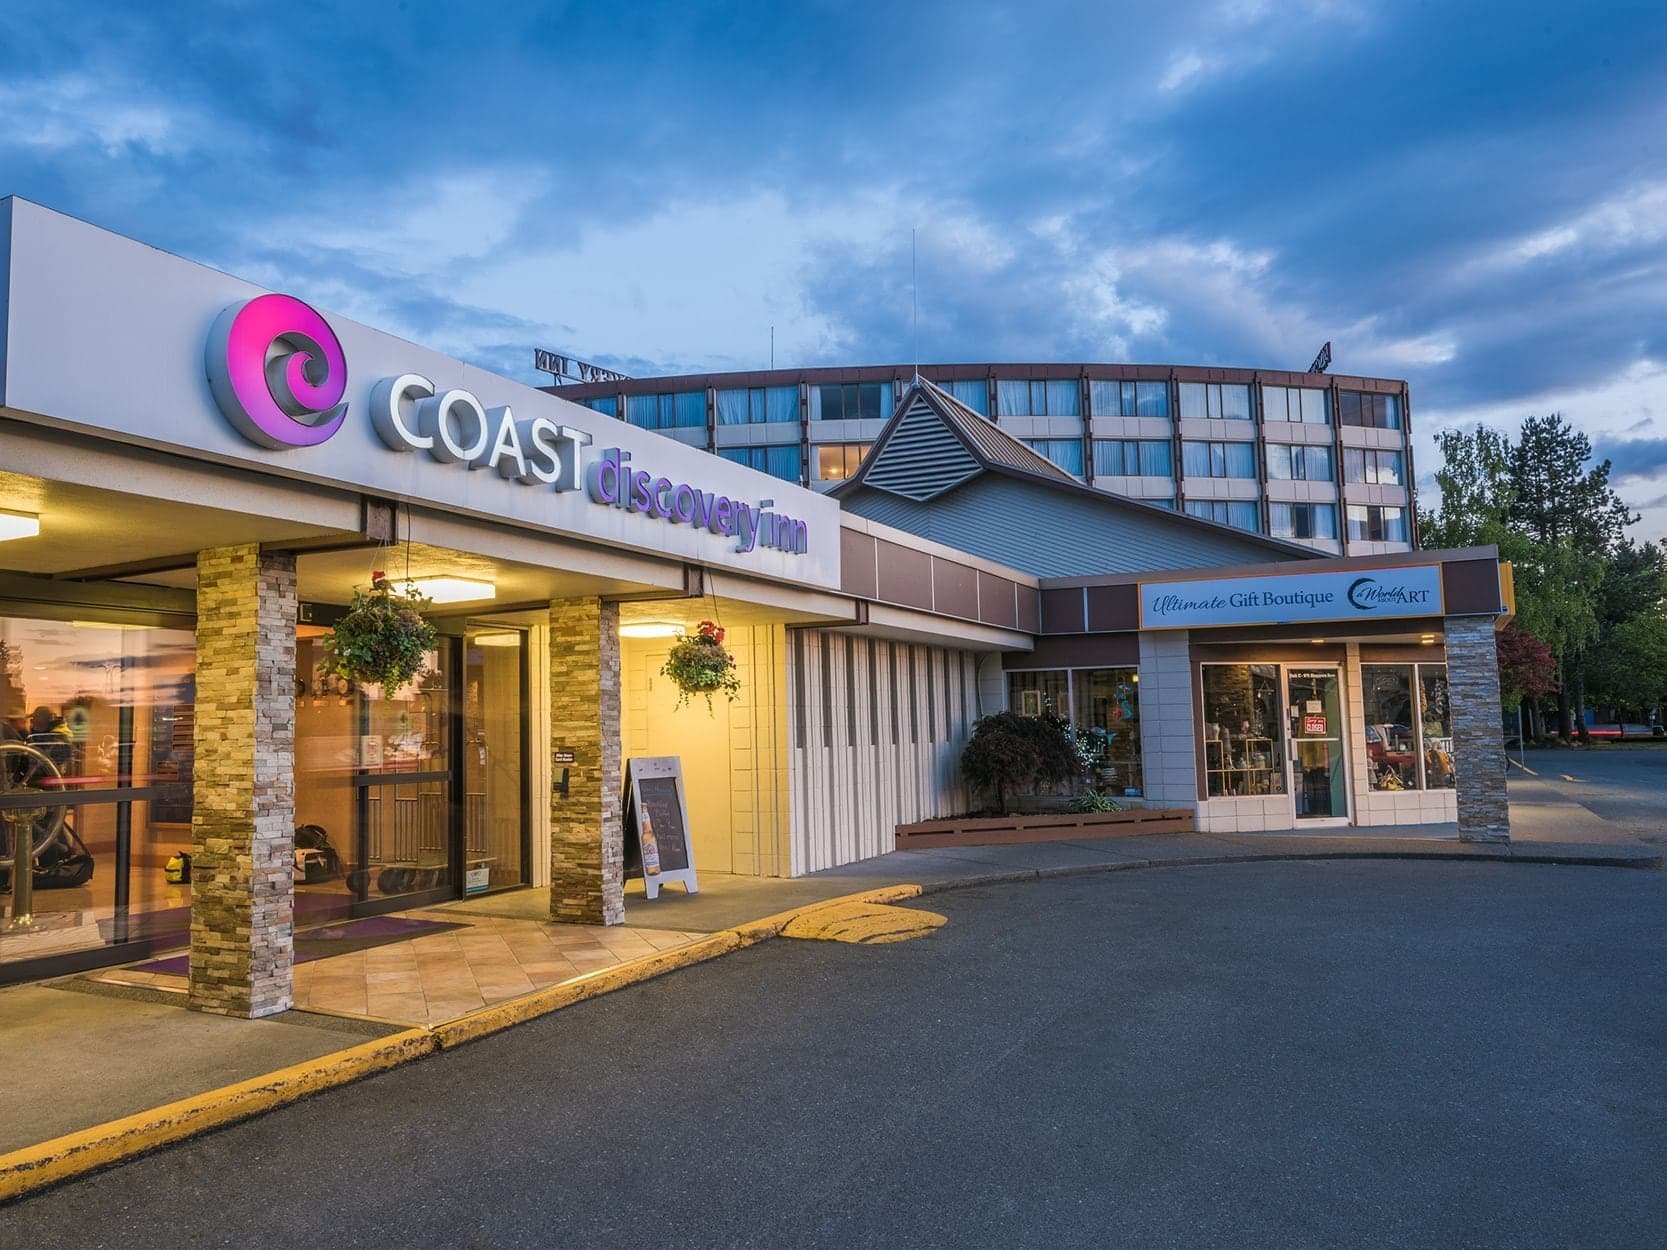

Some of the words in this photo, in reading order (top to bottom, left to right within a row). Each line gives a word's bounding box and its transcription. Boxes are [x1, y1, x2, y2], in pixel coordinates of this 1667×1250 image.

[378, 373, 592, 493] COAST
[596, 447, 761, 553] discovery
[765, 500, 808, 554] inn
[1153, 595, 1226, 615] Ultimate
[1230, 591, 1259, 607] Gift
[1263, 590, 1335, 608] Boutique
[1361, 586, 1404, 601] World
[1397, 590, 1430, 604] ART
